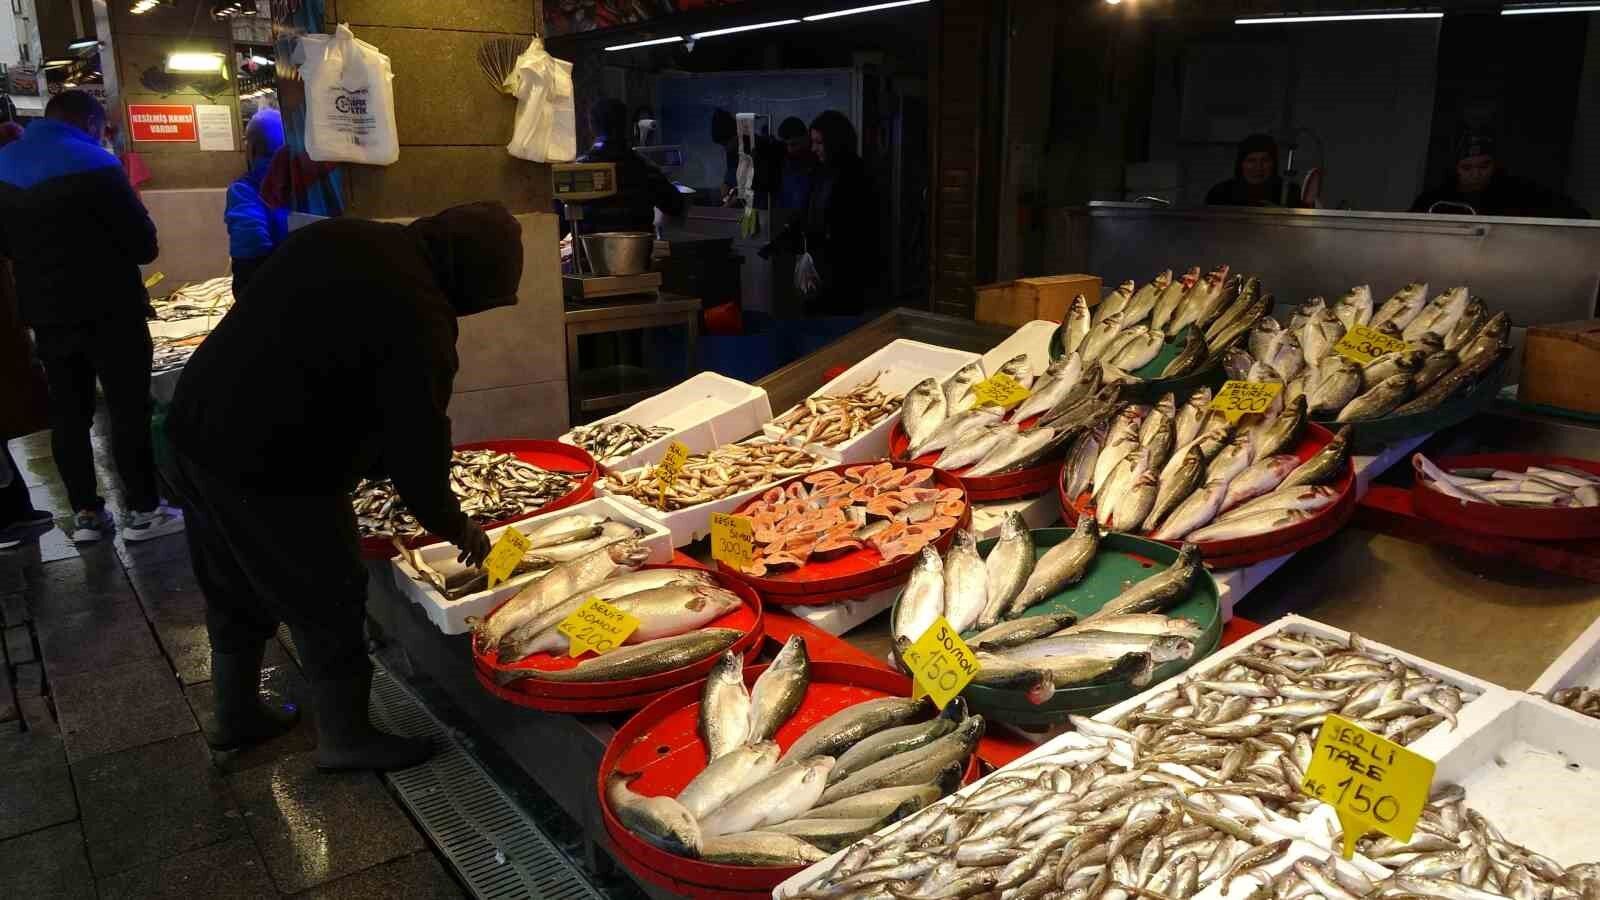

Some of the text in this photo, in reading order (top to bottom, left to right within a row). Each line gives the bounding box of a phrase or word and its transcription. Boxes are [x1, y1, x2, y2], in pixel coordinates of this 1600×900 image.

[575, 626, 614, 652] 200
[921, 649, 959, 691] 150
[1337, 775, 1400, 824] 150
